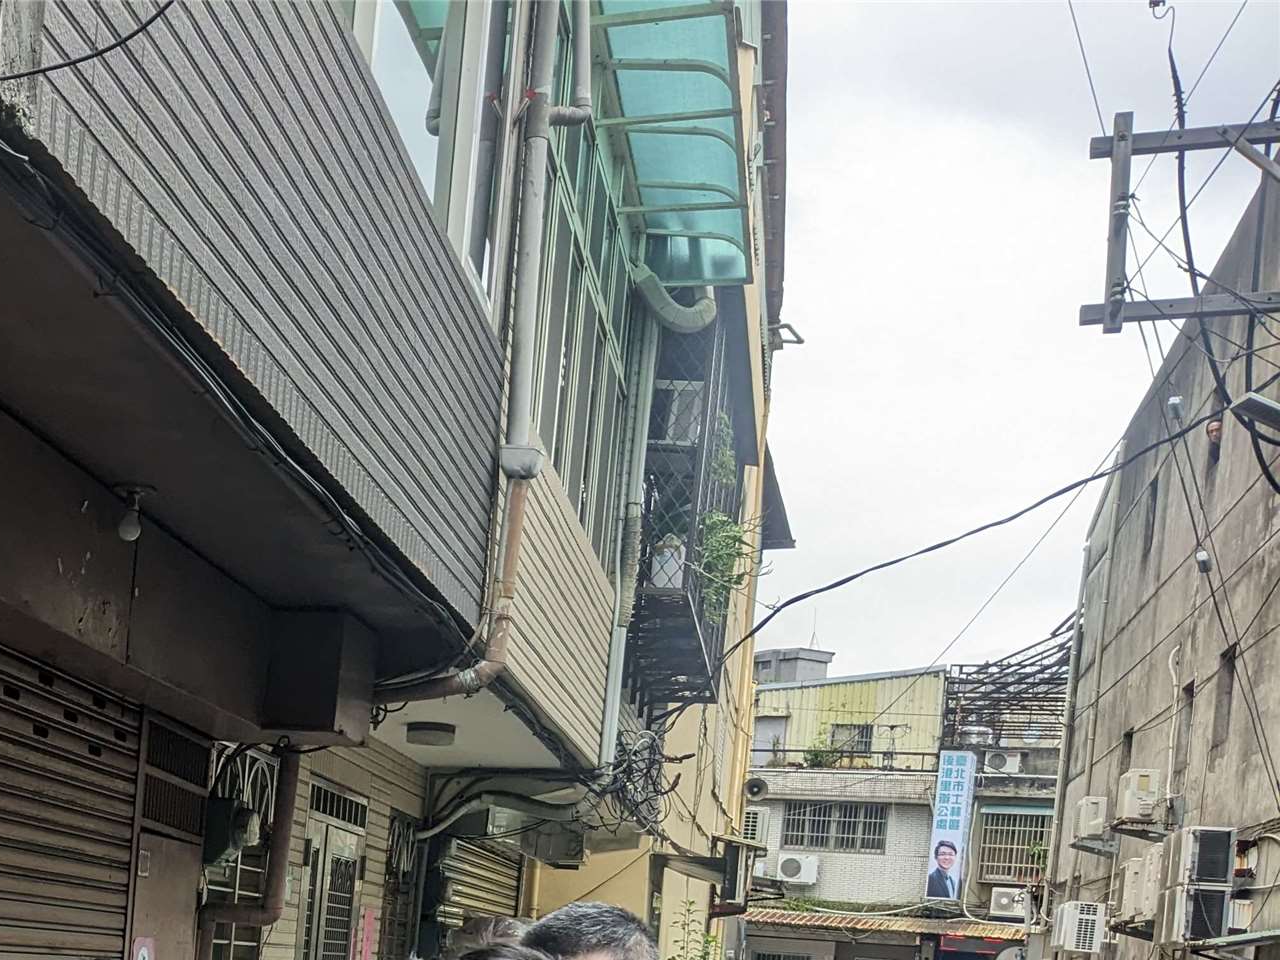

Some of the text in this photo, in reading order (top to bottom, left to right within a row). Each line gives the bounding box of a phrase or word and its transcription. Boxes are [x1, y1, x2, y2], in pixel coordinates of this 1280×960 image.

[935, 754, 955, 830] 後港里辦公處
